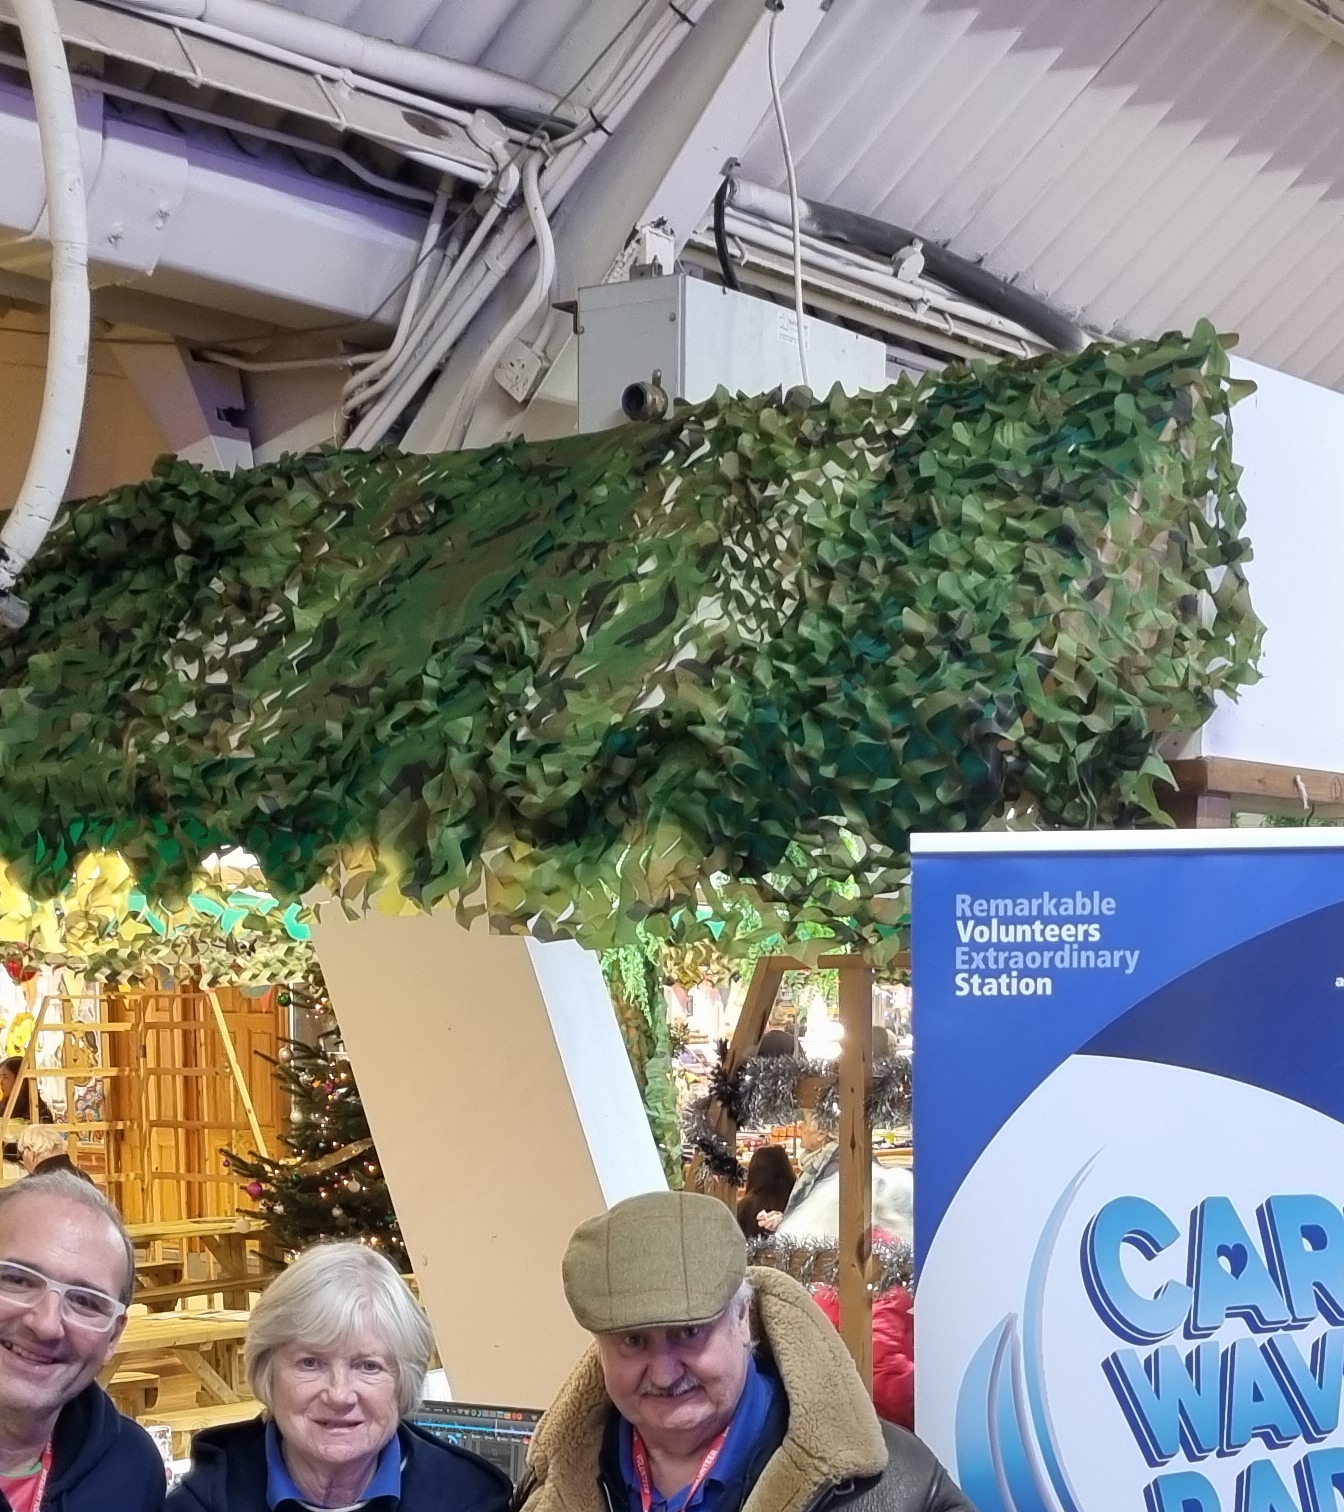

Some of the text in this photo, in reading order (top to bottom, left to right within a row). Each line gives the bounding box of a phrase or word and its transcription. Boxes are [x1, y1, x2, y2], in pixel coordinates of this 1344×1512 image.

[956, 891, 1116, 917] Remarkable
[956, 918, 1101, 943] Volunteers
[956, 944, 1140, 975] Extraordinary
[955, 971, 1052, 996] Station
